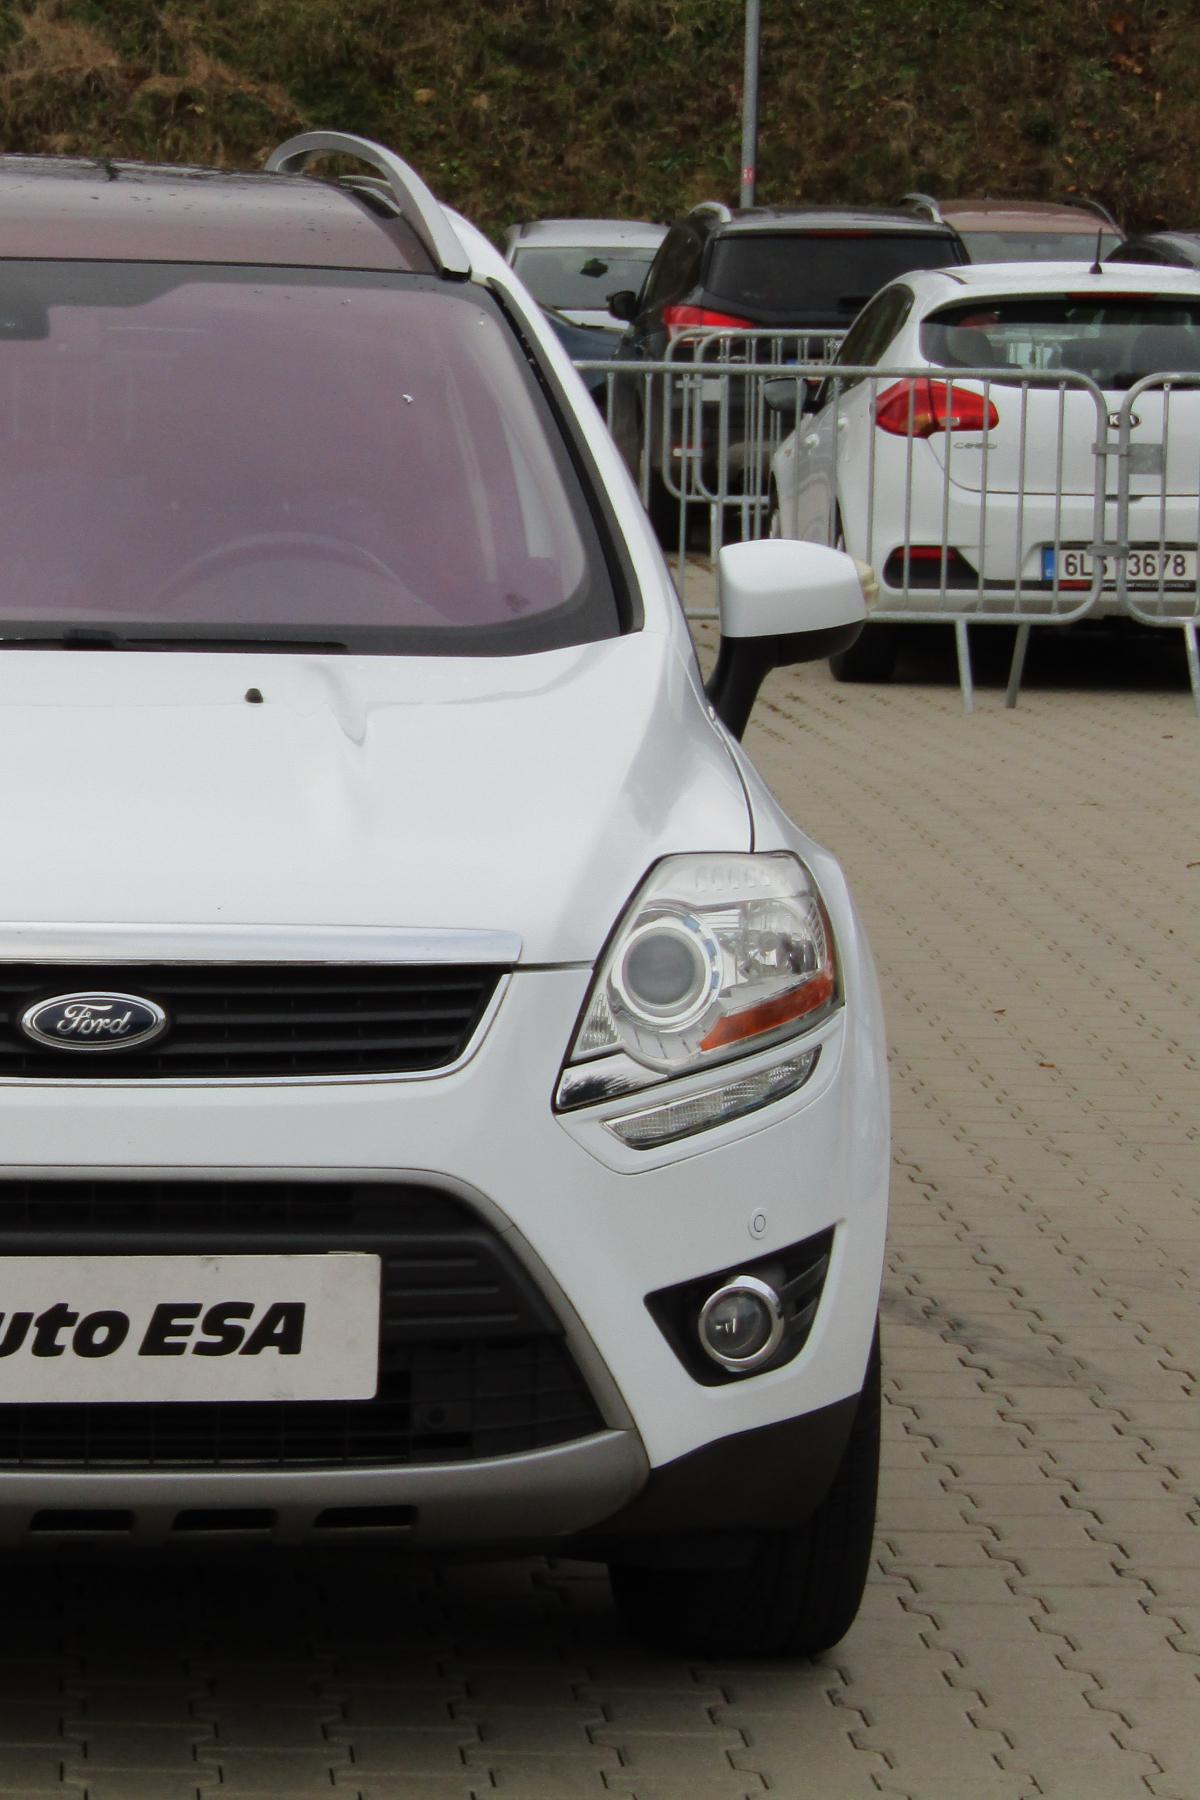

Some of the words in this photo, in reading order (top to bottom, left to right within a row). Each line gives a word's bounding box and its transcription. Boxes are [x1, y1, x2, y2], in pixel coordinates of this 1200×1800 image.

[1128, 554, 1186, 577] 3678
[56, 1003, 133, 1035] Ford
[137, 1301, 306, 1356] ESA
